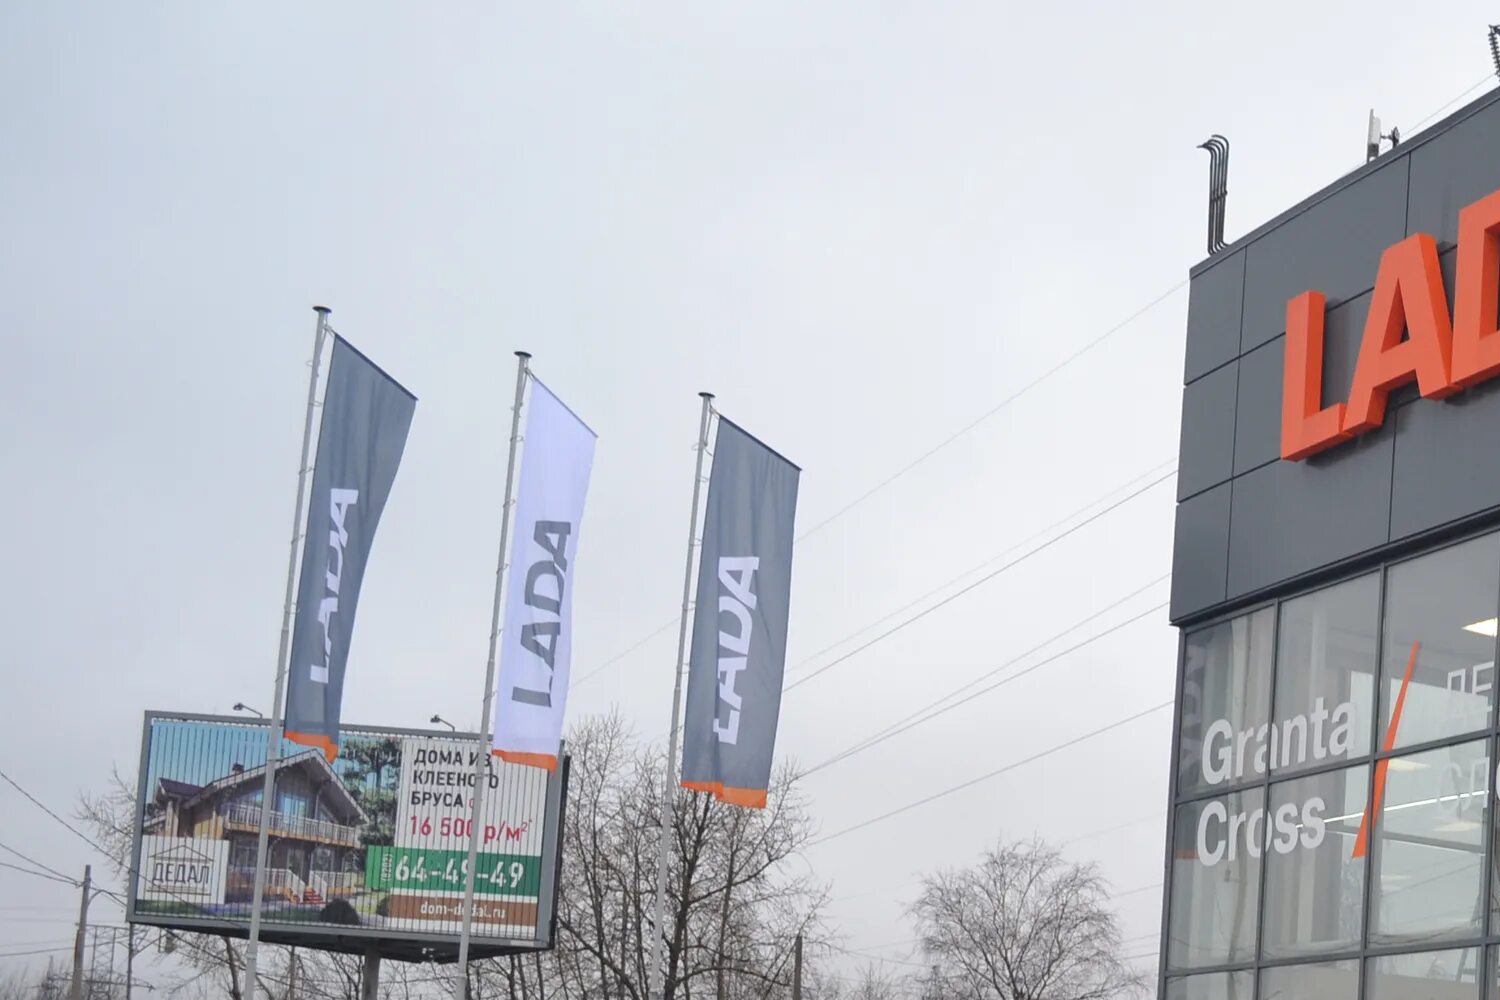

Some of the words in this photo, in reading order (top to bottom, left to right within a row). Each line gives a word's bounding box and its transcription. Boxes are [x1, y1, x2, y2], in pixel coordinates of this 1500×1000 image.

[310, 488, 359, 684] LADA
[512, 520, 572, 708] LADA
[712, 556, 760, 745] LADA
[413, 748, 464, 767] ДОМА
[1202, 696, 1357, 785] Granta
[410, 790, 464, 808] БРУСА
[412, 769, 499, 789] КЛЕЕНОО
[411, 815, 432, 837] 16
[1197, 796, 1327, 866] Cross
[152, 862, 210, 885] ДЕДАЛ
